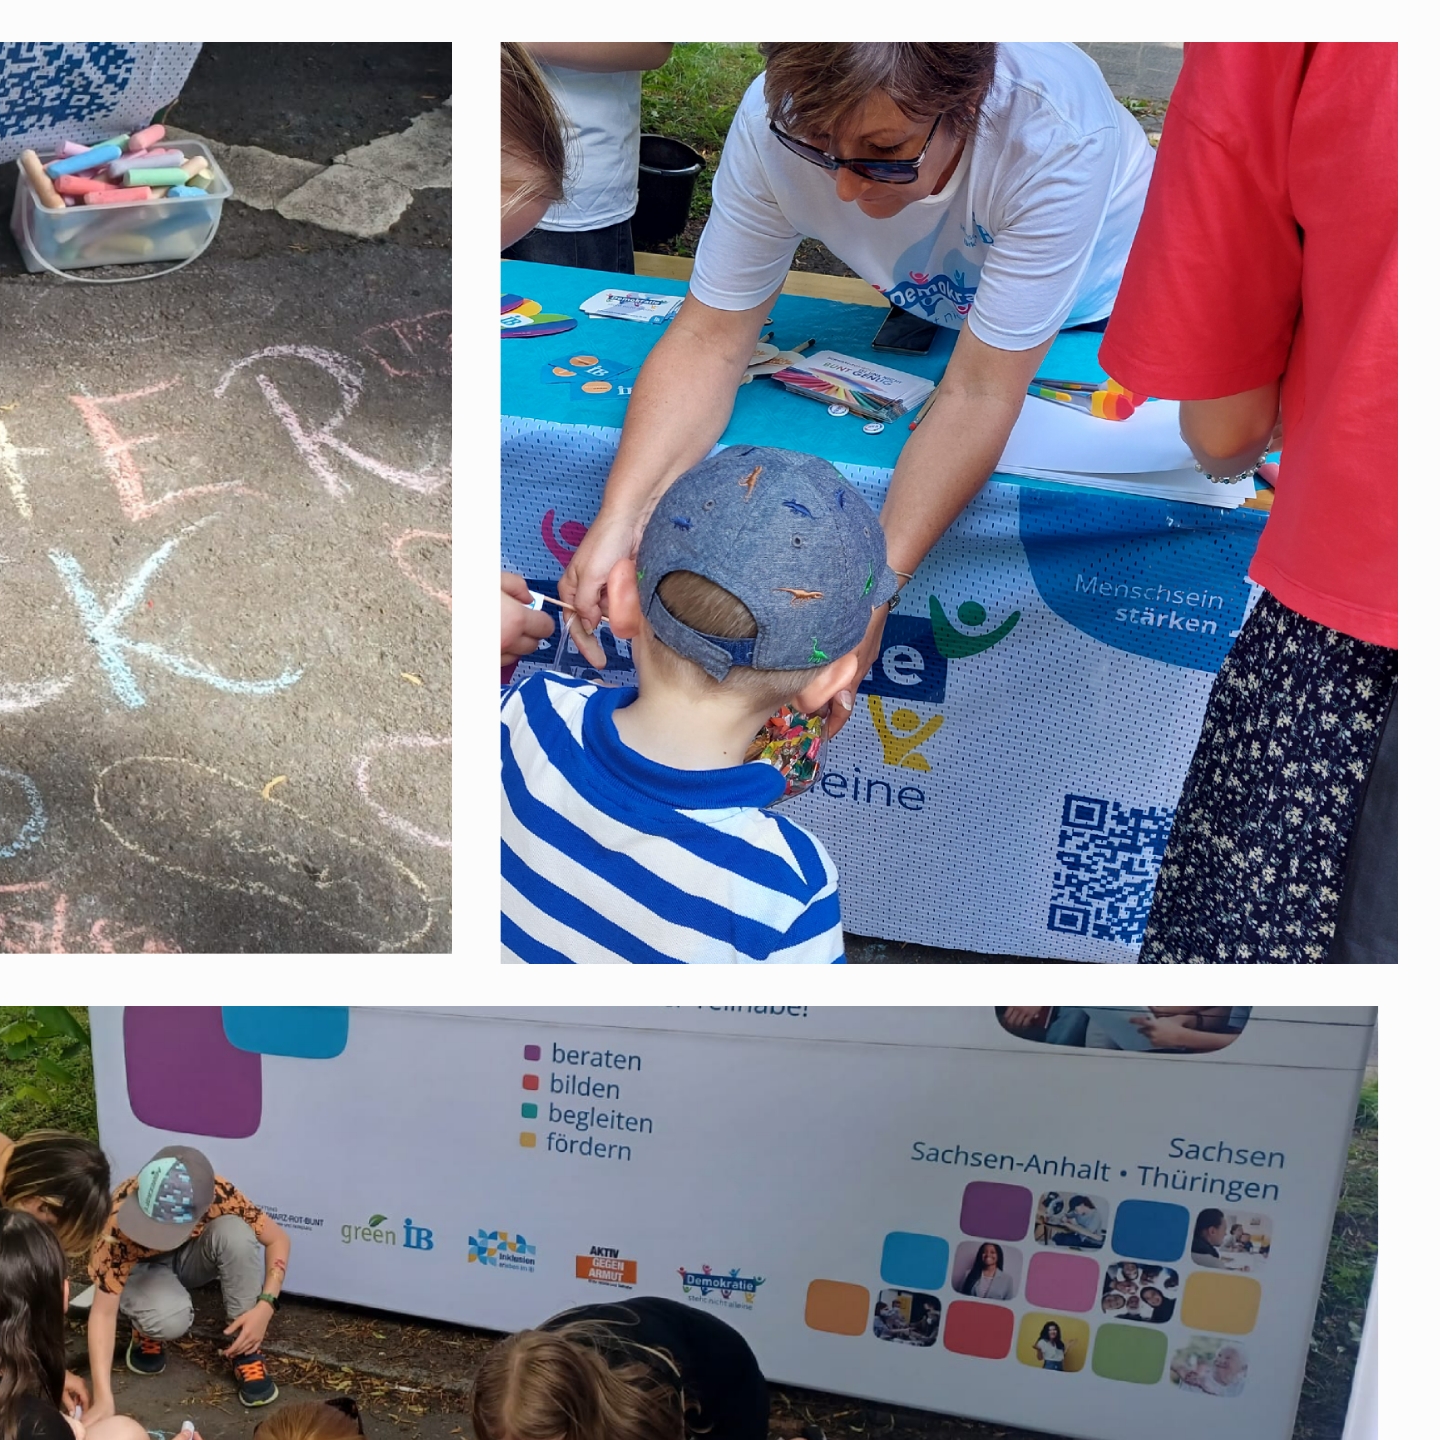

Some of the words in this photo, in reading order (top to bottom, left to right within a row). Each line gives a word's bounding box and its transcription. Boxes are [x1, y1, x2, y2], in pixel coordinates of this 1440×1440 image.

[889, 277, 977, 310] Demokra
[1074, 573, 1225, 612] Menschsein
[1114, 604, 1220, 637] stärken
[551, 1042, 642, 1072] beraten
[549, 1071, 621, 1101] bilden
[548, 1101, 654, 1135] begleiten
[546, 1131, 632, 1162] fördern
[1168, 1136, 1286, 1171] Sachsen
[910, 1140, 1111, 1184] Sachsen-Anhalt
[1135, 1164, 1280, 1204] Thüringen
[266, 1212, 325, 1227] WARZ-ROT-BUNT
[341, 1223, 397, 1246] green
[498, 1252, 536, 1266] Inklusion
[589, 1245, 620, 1259] AKTIV
[592, 1258, 625, 1272] GEGEN
[588, 1268, 625, 1283] ARMUT
[686, 1274, 755, 1292] Demokratie
